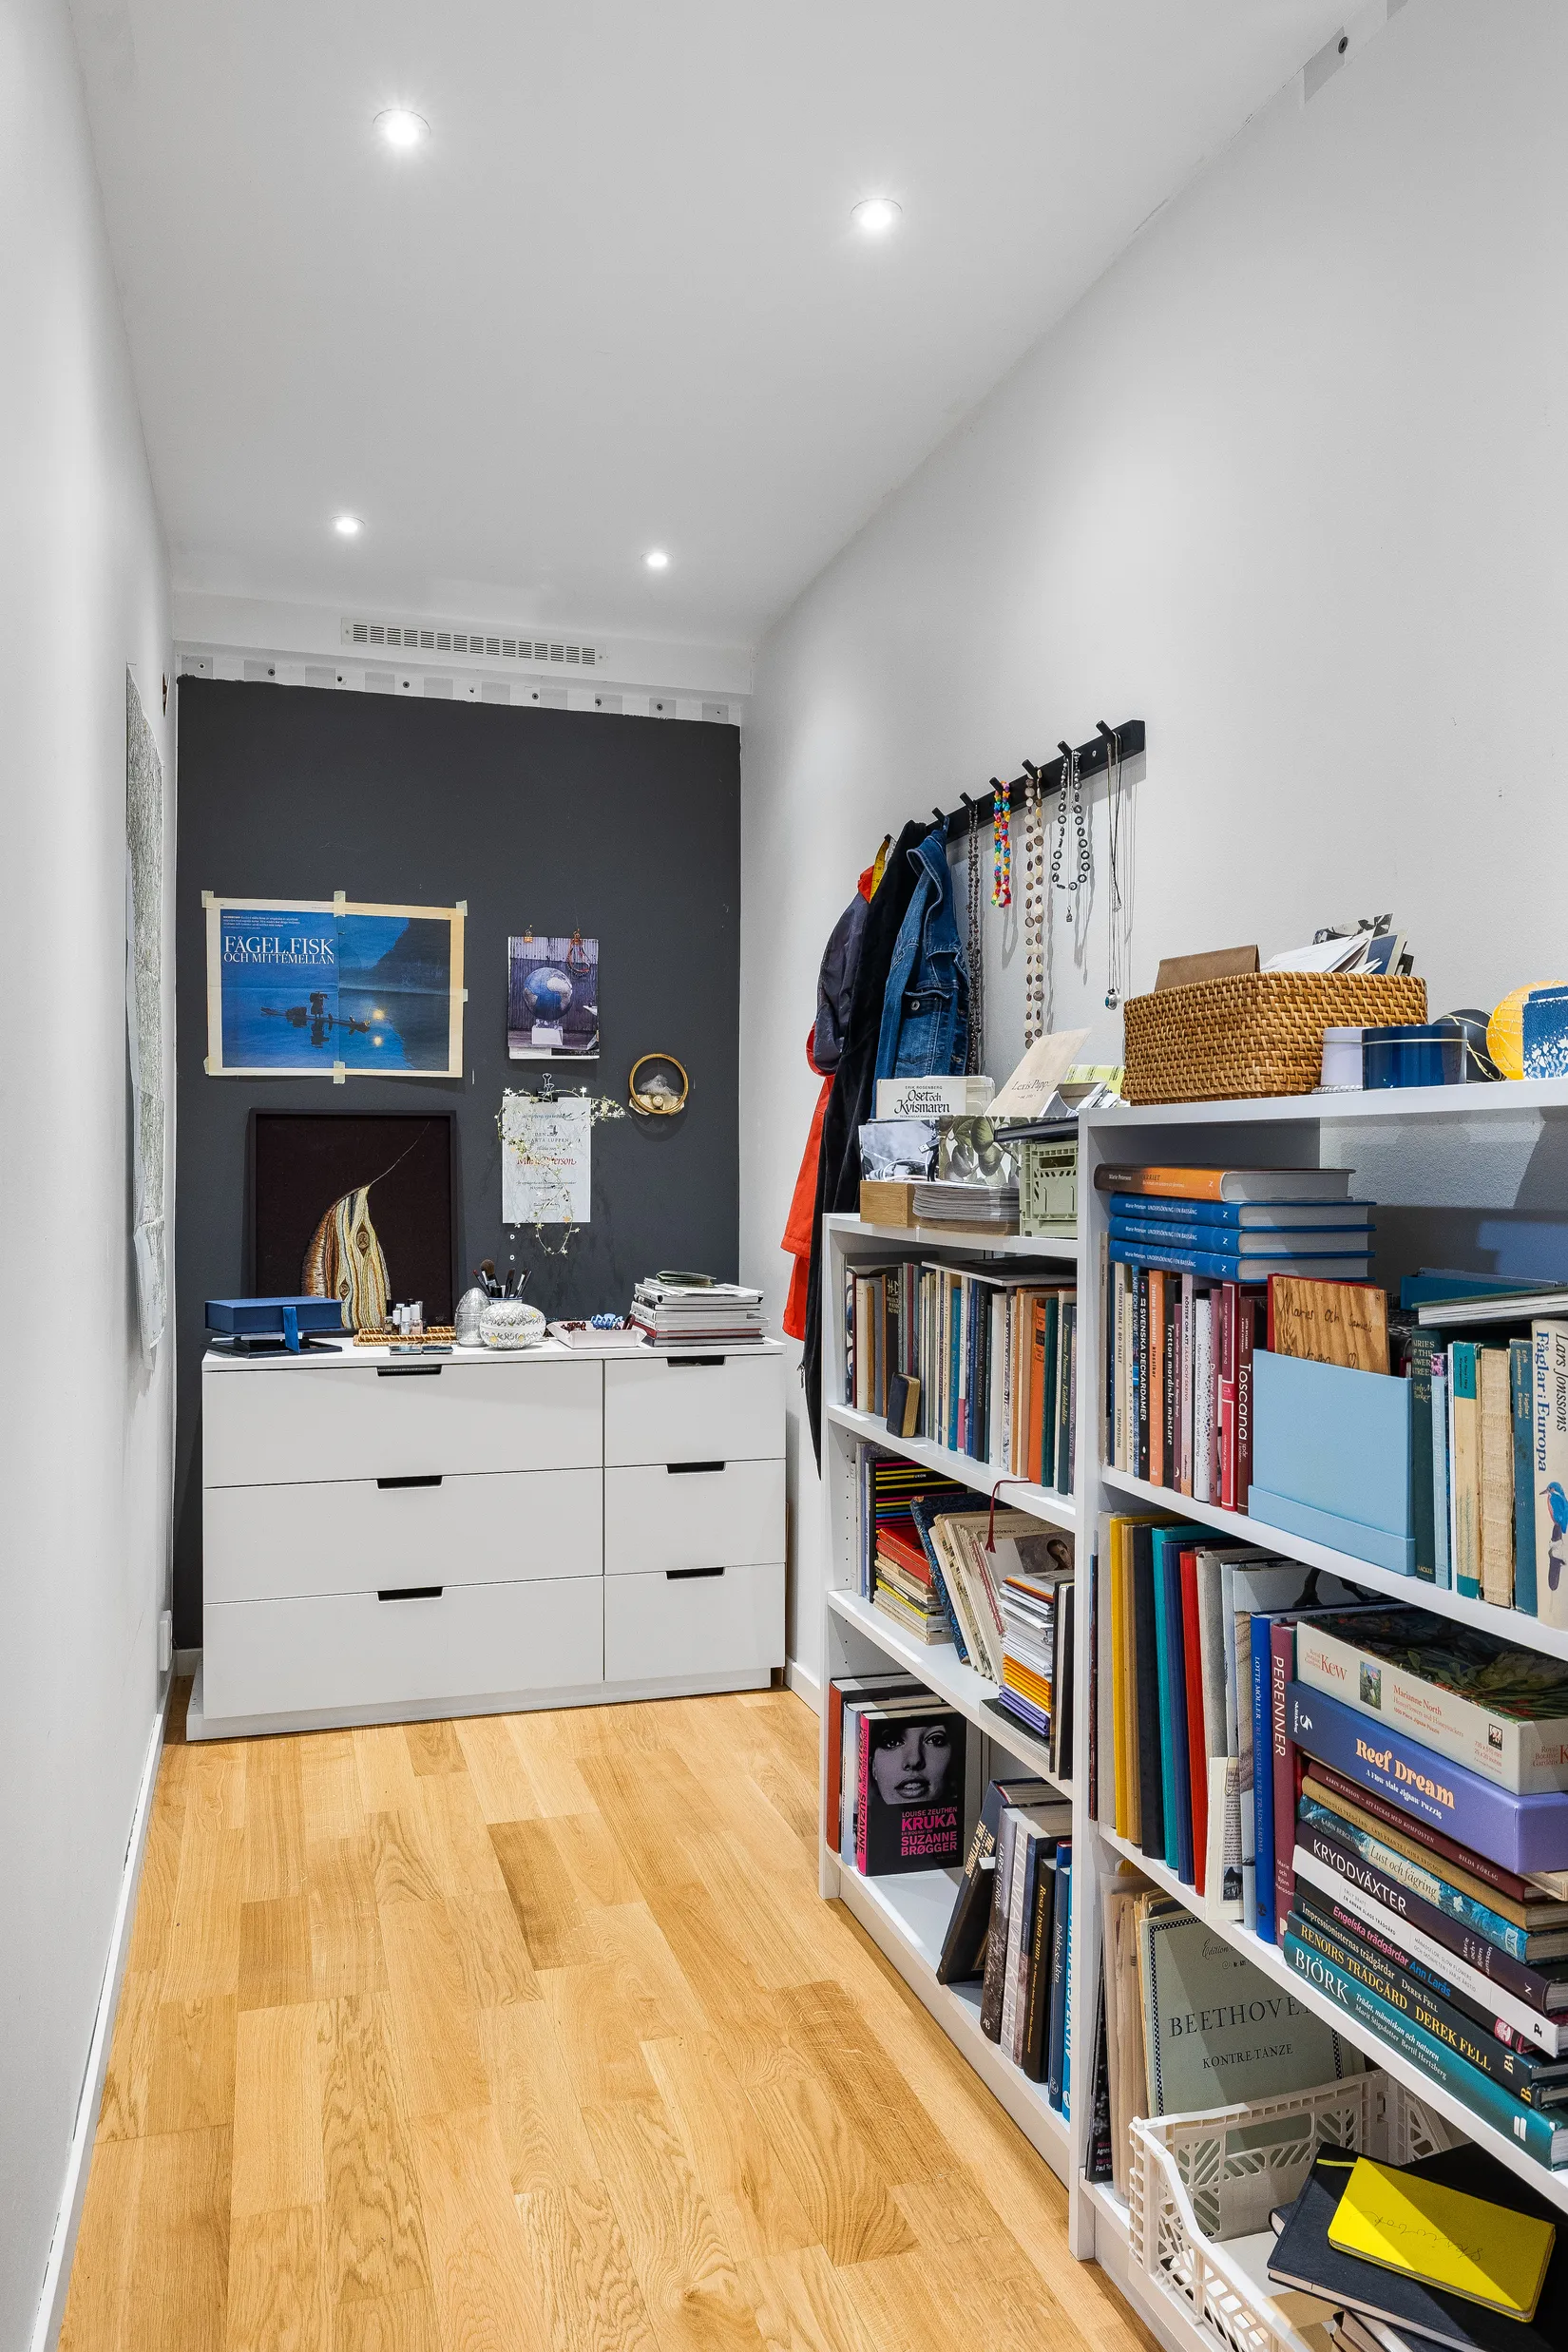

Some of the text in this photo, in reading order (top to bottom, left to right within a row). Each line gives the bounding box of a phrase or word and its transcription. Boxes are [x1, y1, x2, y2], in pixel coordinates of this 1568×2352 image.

[223, 952, 335, 965] OCH MITTEMELLAN
[290, 937, 335, 955] FISK
[893, 1100, 950, 1115] Kvismaren
[908, 1089, 942, 1102] Oset och
[1147, 1205, 1174, 1214] UNDERSÖKNING
[1147, 1228, 1174, 1237] UNDERSÖKNING
[1181, 1231, 1197, 1239] BASSÄNG
[1146, 1253, 1173, 1263] UNDERSÖKNING
[1180, 1256, 1196, 1265] BASSÄNG
[1184, 1321, 1190, 1332] OM
[1418, 1348, 1433, 1357] THE
[1535, 1330, 1550, 1392] Fåglar
[1211, 1363, 1216, 1374] Du
[1553, 1332, 1568, 1433] Lars Jonssons
[1238, 1363, 1252, 1441] Toscana
[1433, 1408, 1443, 1444] country
[1536, 1400, 1551, 1472] Europa
[1434, 1444, 1444, 1478] garden
[1321, 1654, 1348, 1681] Kew
[1273, 1655, 1286, 1757] PERENNER
[1392, 1684, 1442, 1717] Marianne North
[1393, 1707, 1440, 1735] 1000 Piece Jigsaw Puzzle
[1355, 1737, 1393, 1773] Reef
[1394, 1759, 1456, 1811] Dream
[901, 1807, 958, 1818] LOUISE ZEUTHEN
[901, 1813, 957, 1832] KRUKA
[901, 1831, 958, 1846] SUZANNE
[976, 1820, 986, 1841] THE
[1325, 1776, 1499, 1882] KARIN PERSSON ATT LYCKAS MED KOMPOSTEN FÖRLAG
[901, 1841, 958, 1857] BRØGGER
[965, 1836, 982, 1879] PYTHONS
[997, 1843, 1005, 1873] LARS
[1321, 1817, 1438, 1901] KARIN Lust och fägring
[1009, 1830, 1026, 1923] HILMA
[1278, 1869, 1288, 1878] och
[1312, 1839, 1407, 1916] KRYDDVÄXTER
[1038, 1884, 1046, 1907] Resa
[1035, 1916, 1044, 1939] tysta
[1202, 1939, 1233, 1960] Edition
[1302, 1902, 1439, 2013] Impressionisternas trädgårdar DEREK FELL
[1332, 1905, 1451, 1998] Engelska trädgårdar Ann Larås
[1294, 1946, 1349, 2005] BJÖRK
[1301, 1924, 1492, 2073] RENOIRS TRÄDGÅRD DEREK FELL
[1168, 1996, 1313, 2038] BEETHOVE
[1355, 1992, 1440, 2063] Trädet, människan och naturen
[1354, 2004, 1370, 2020] Marit
[1400, 2038, 1419, 2059] Bertil
[1418, 2049, 1448, 2082] Hertzberg
